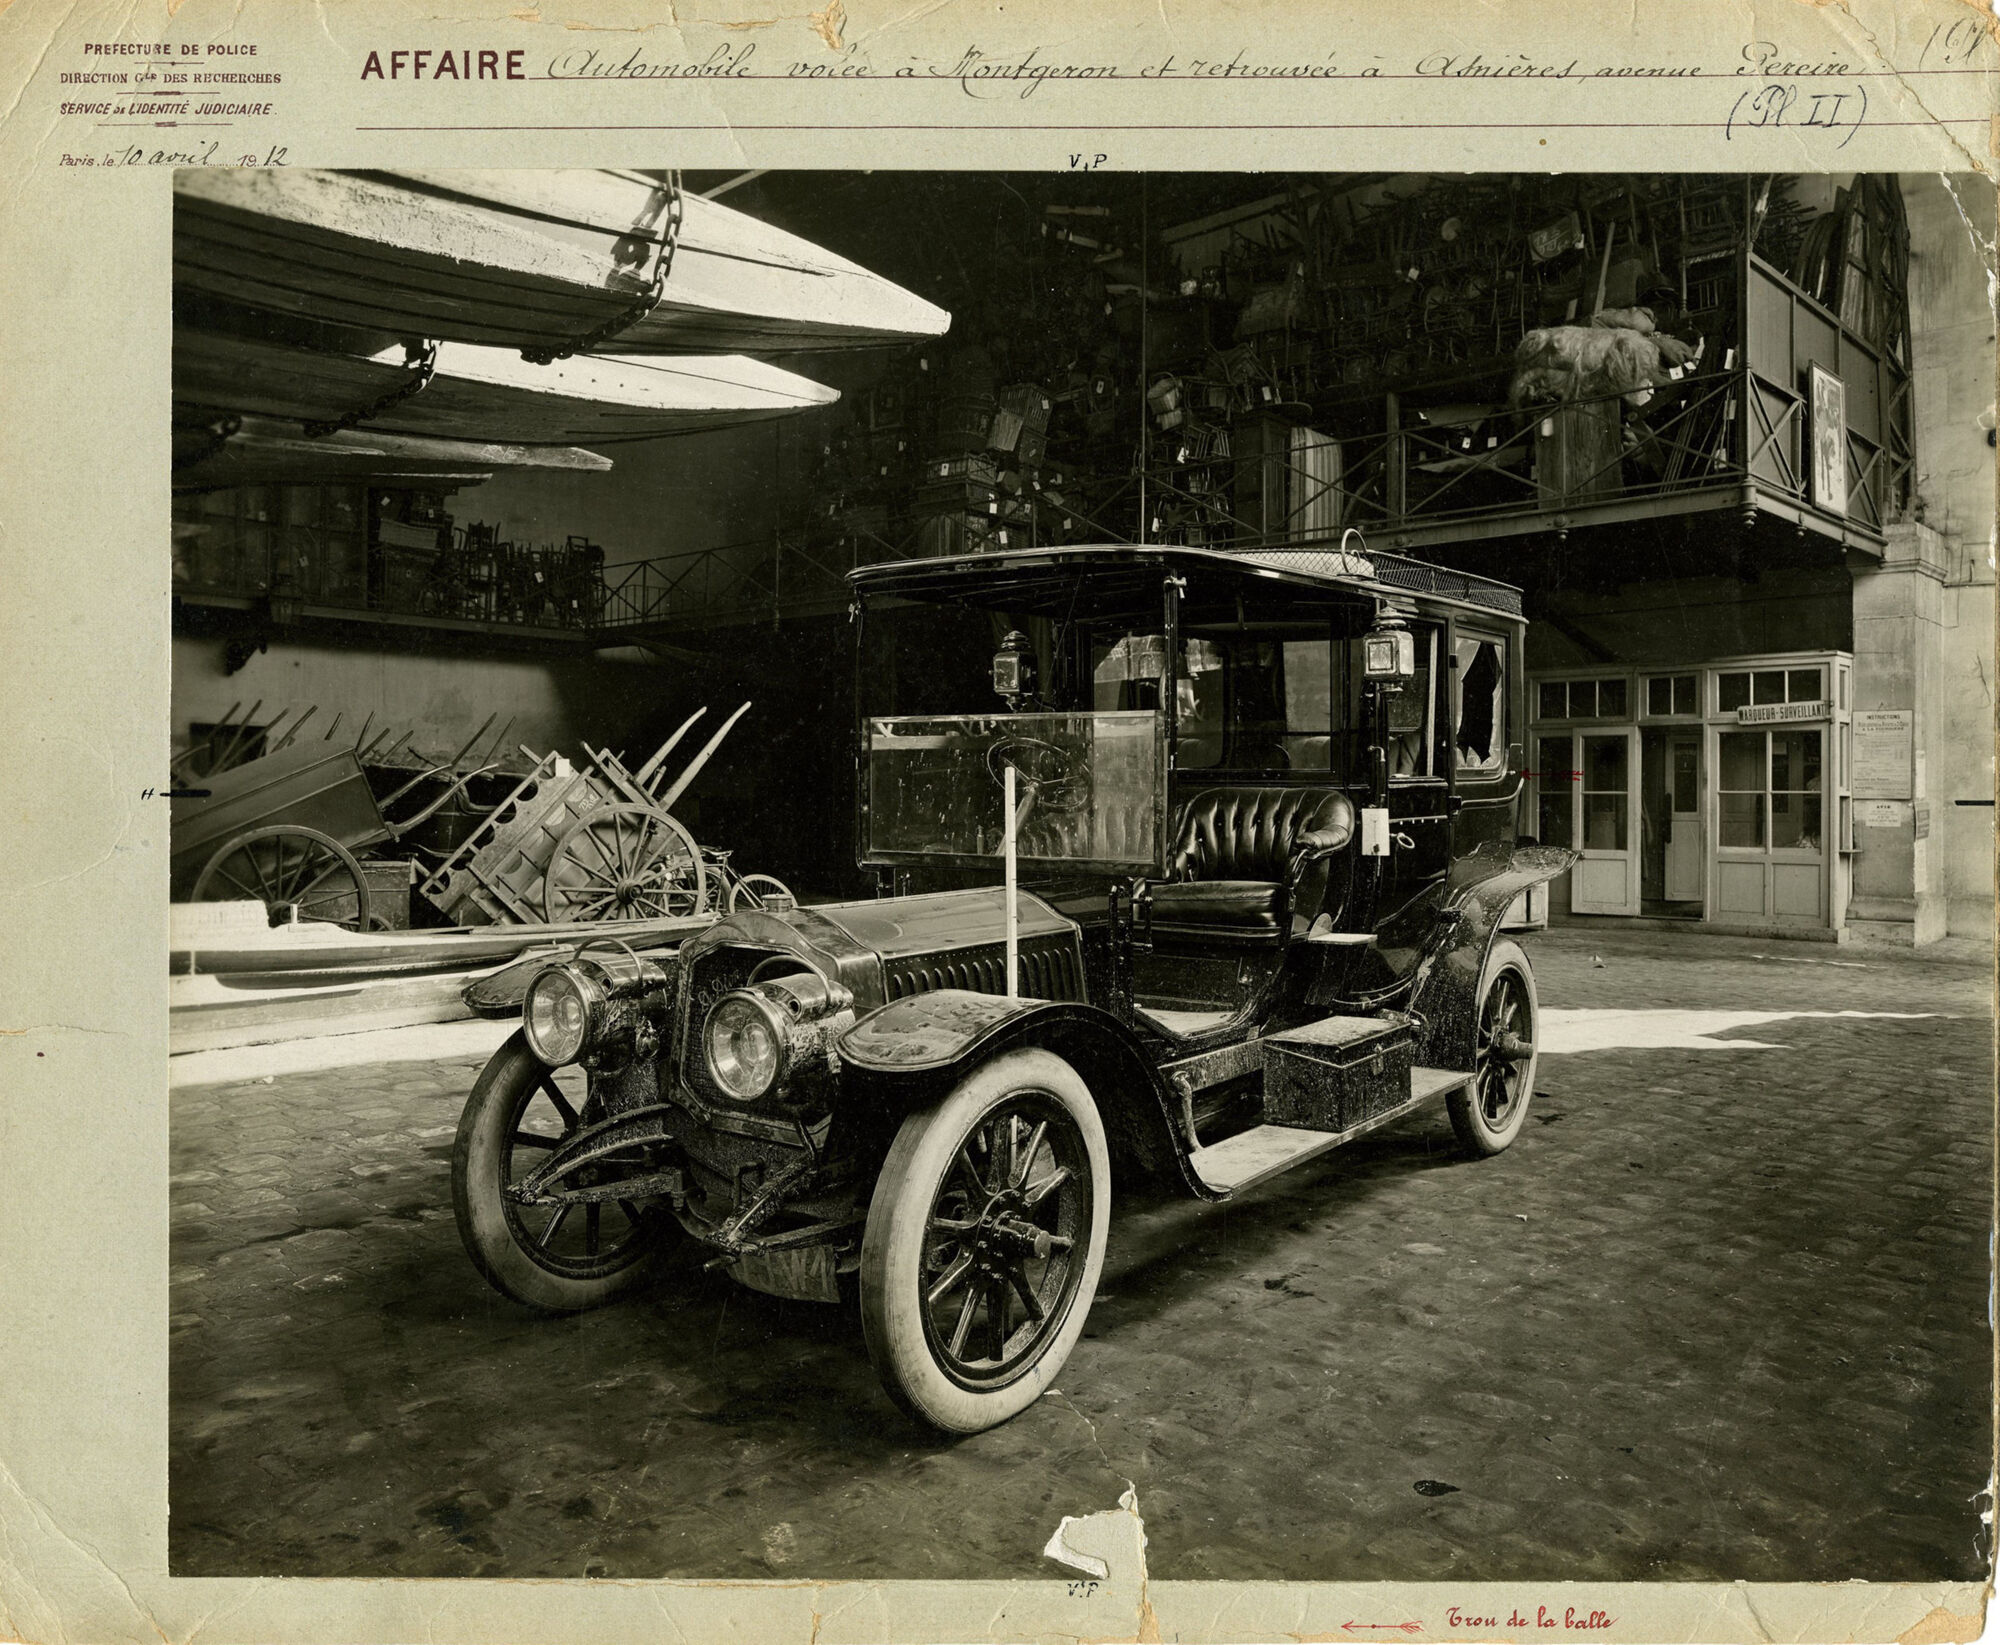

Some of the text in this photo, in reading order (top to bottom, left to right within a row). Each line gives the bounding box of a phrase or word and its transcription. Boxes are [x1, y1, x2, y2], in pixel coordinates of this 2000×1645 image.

[84, 43, 257, 56] PREFECTURE DE POLICE
[361, 50, 526, 80] AFFAIRE
[547, 42, 757, 78] Automobile
[928, 44, 1118, 100] Montgeron
[1140, 55, 1177, 78] et
[1189, 47, 1346, 78] retrouvée
[1595, 64, 1702, 78] avenue
[60, 73, 128, 84] DIRECTION
[163, 73, 188, 84] DES
[193, 73, 282, 84] RECHERCHES
[60, 102, 112, 116] SERVICE
[102, 153, 115, 167] le
[148, 141, 219, 166] avril
[1446, 1605, 1620, 1630] Trou de la balle
